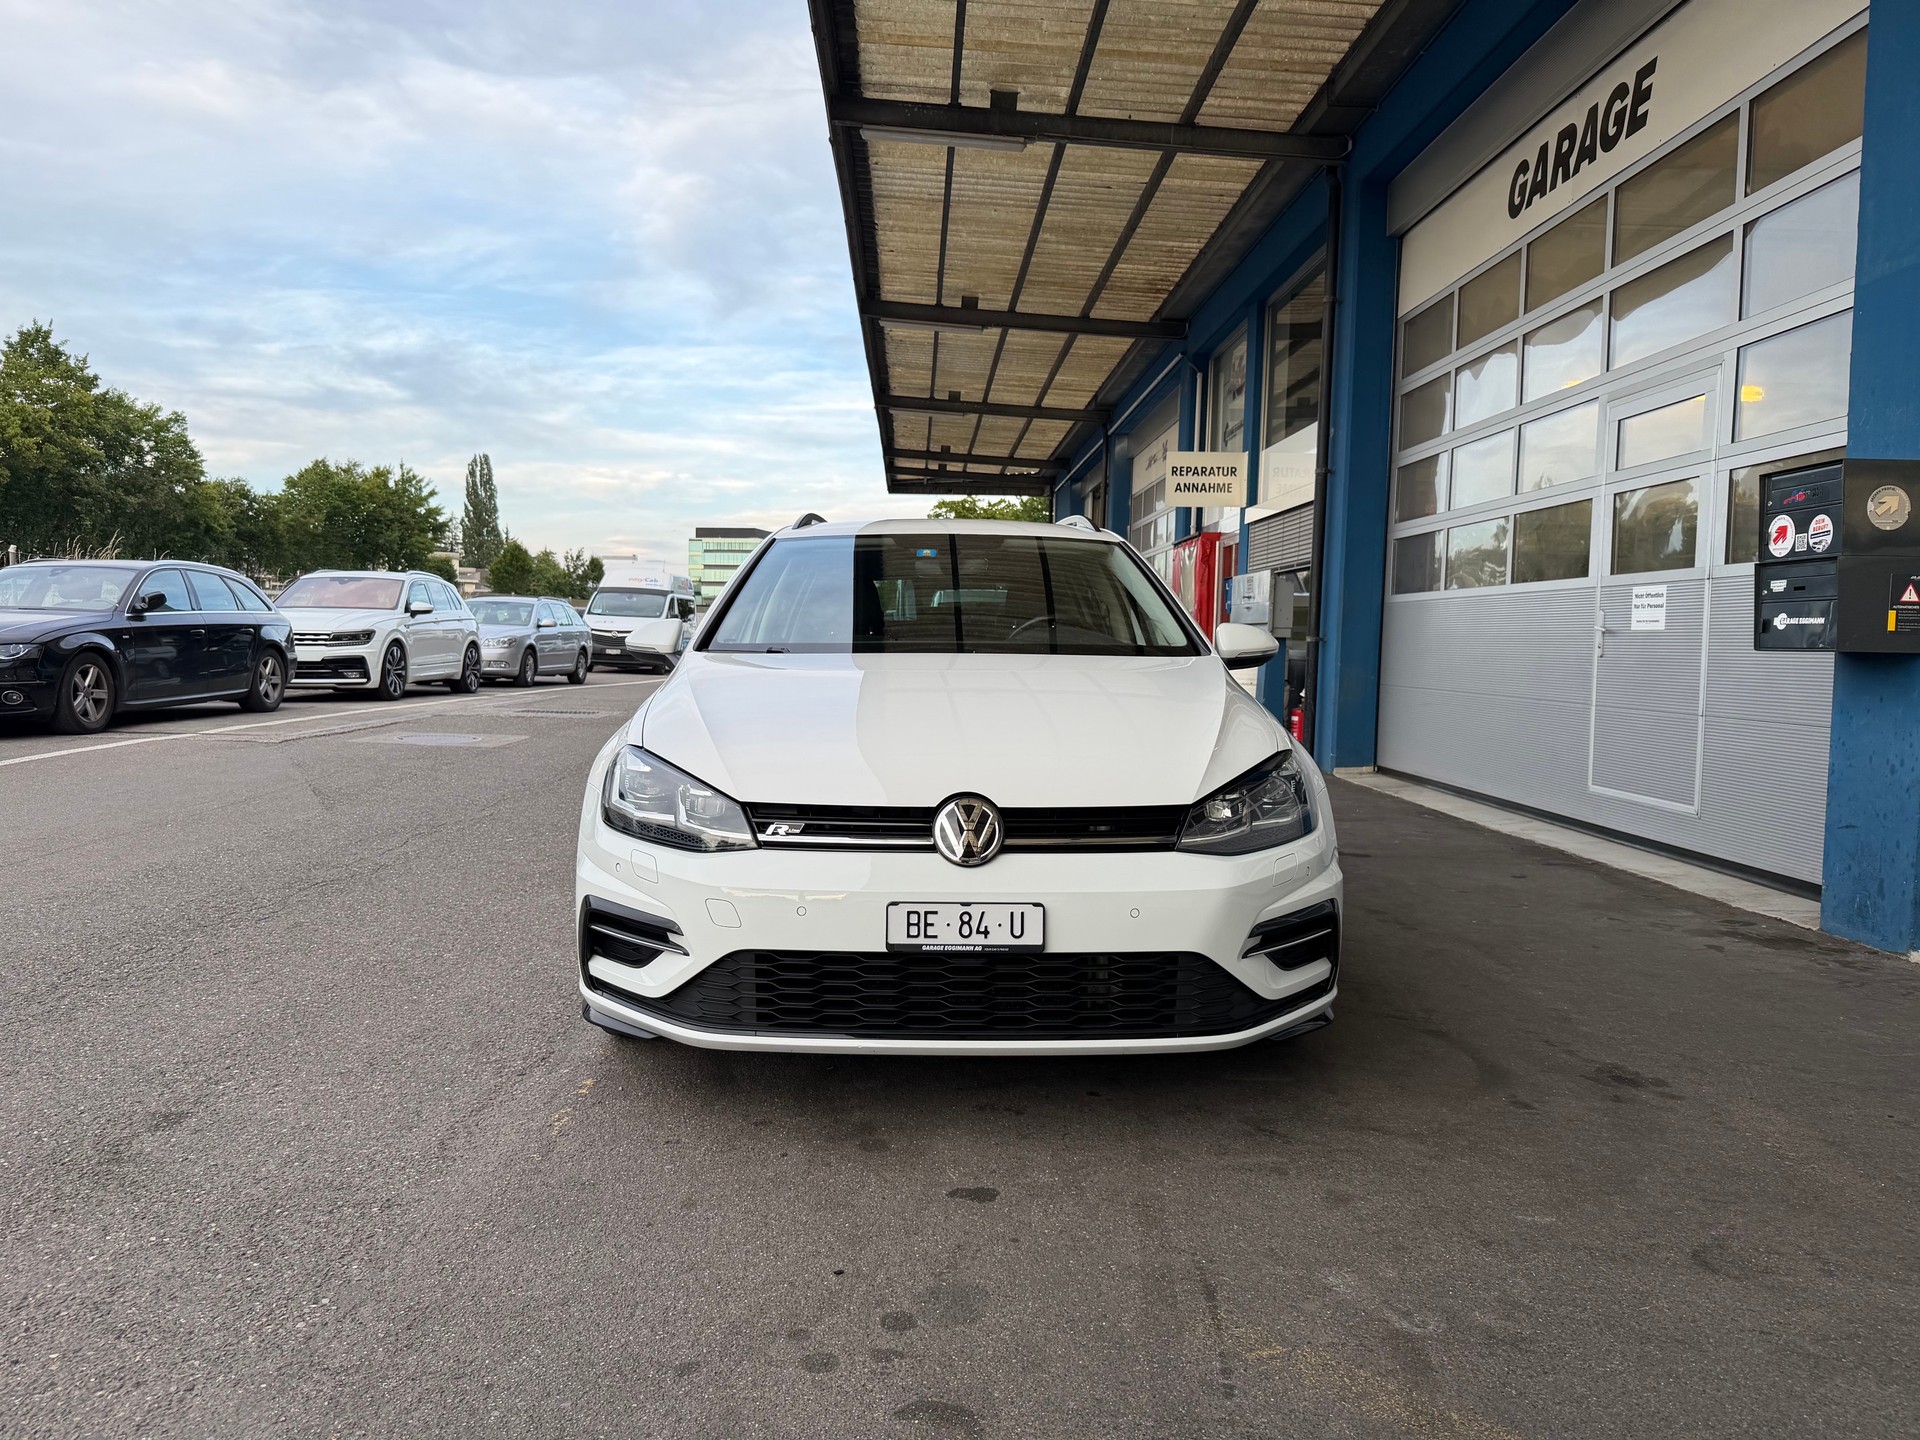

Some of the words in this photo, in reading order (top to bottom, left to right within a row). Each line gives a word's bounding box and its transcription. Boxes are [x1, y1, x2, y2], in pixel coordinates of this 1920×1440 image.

[1508, 55, 1658, 219] GARAGE
[1171, 466, 1238, 477] REPARATUR
[1174, 483, 1233, 493] ANNAHME
[958, 911, 990, 939] 84
[1010, 911, 1025, 939] U
